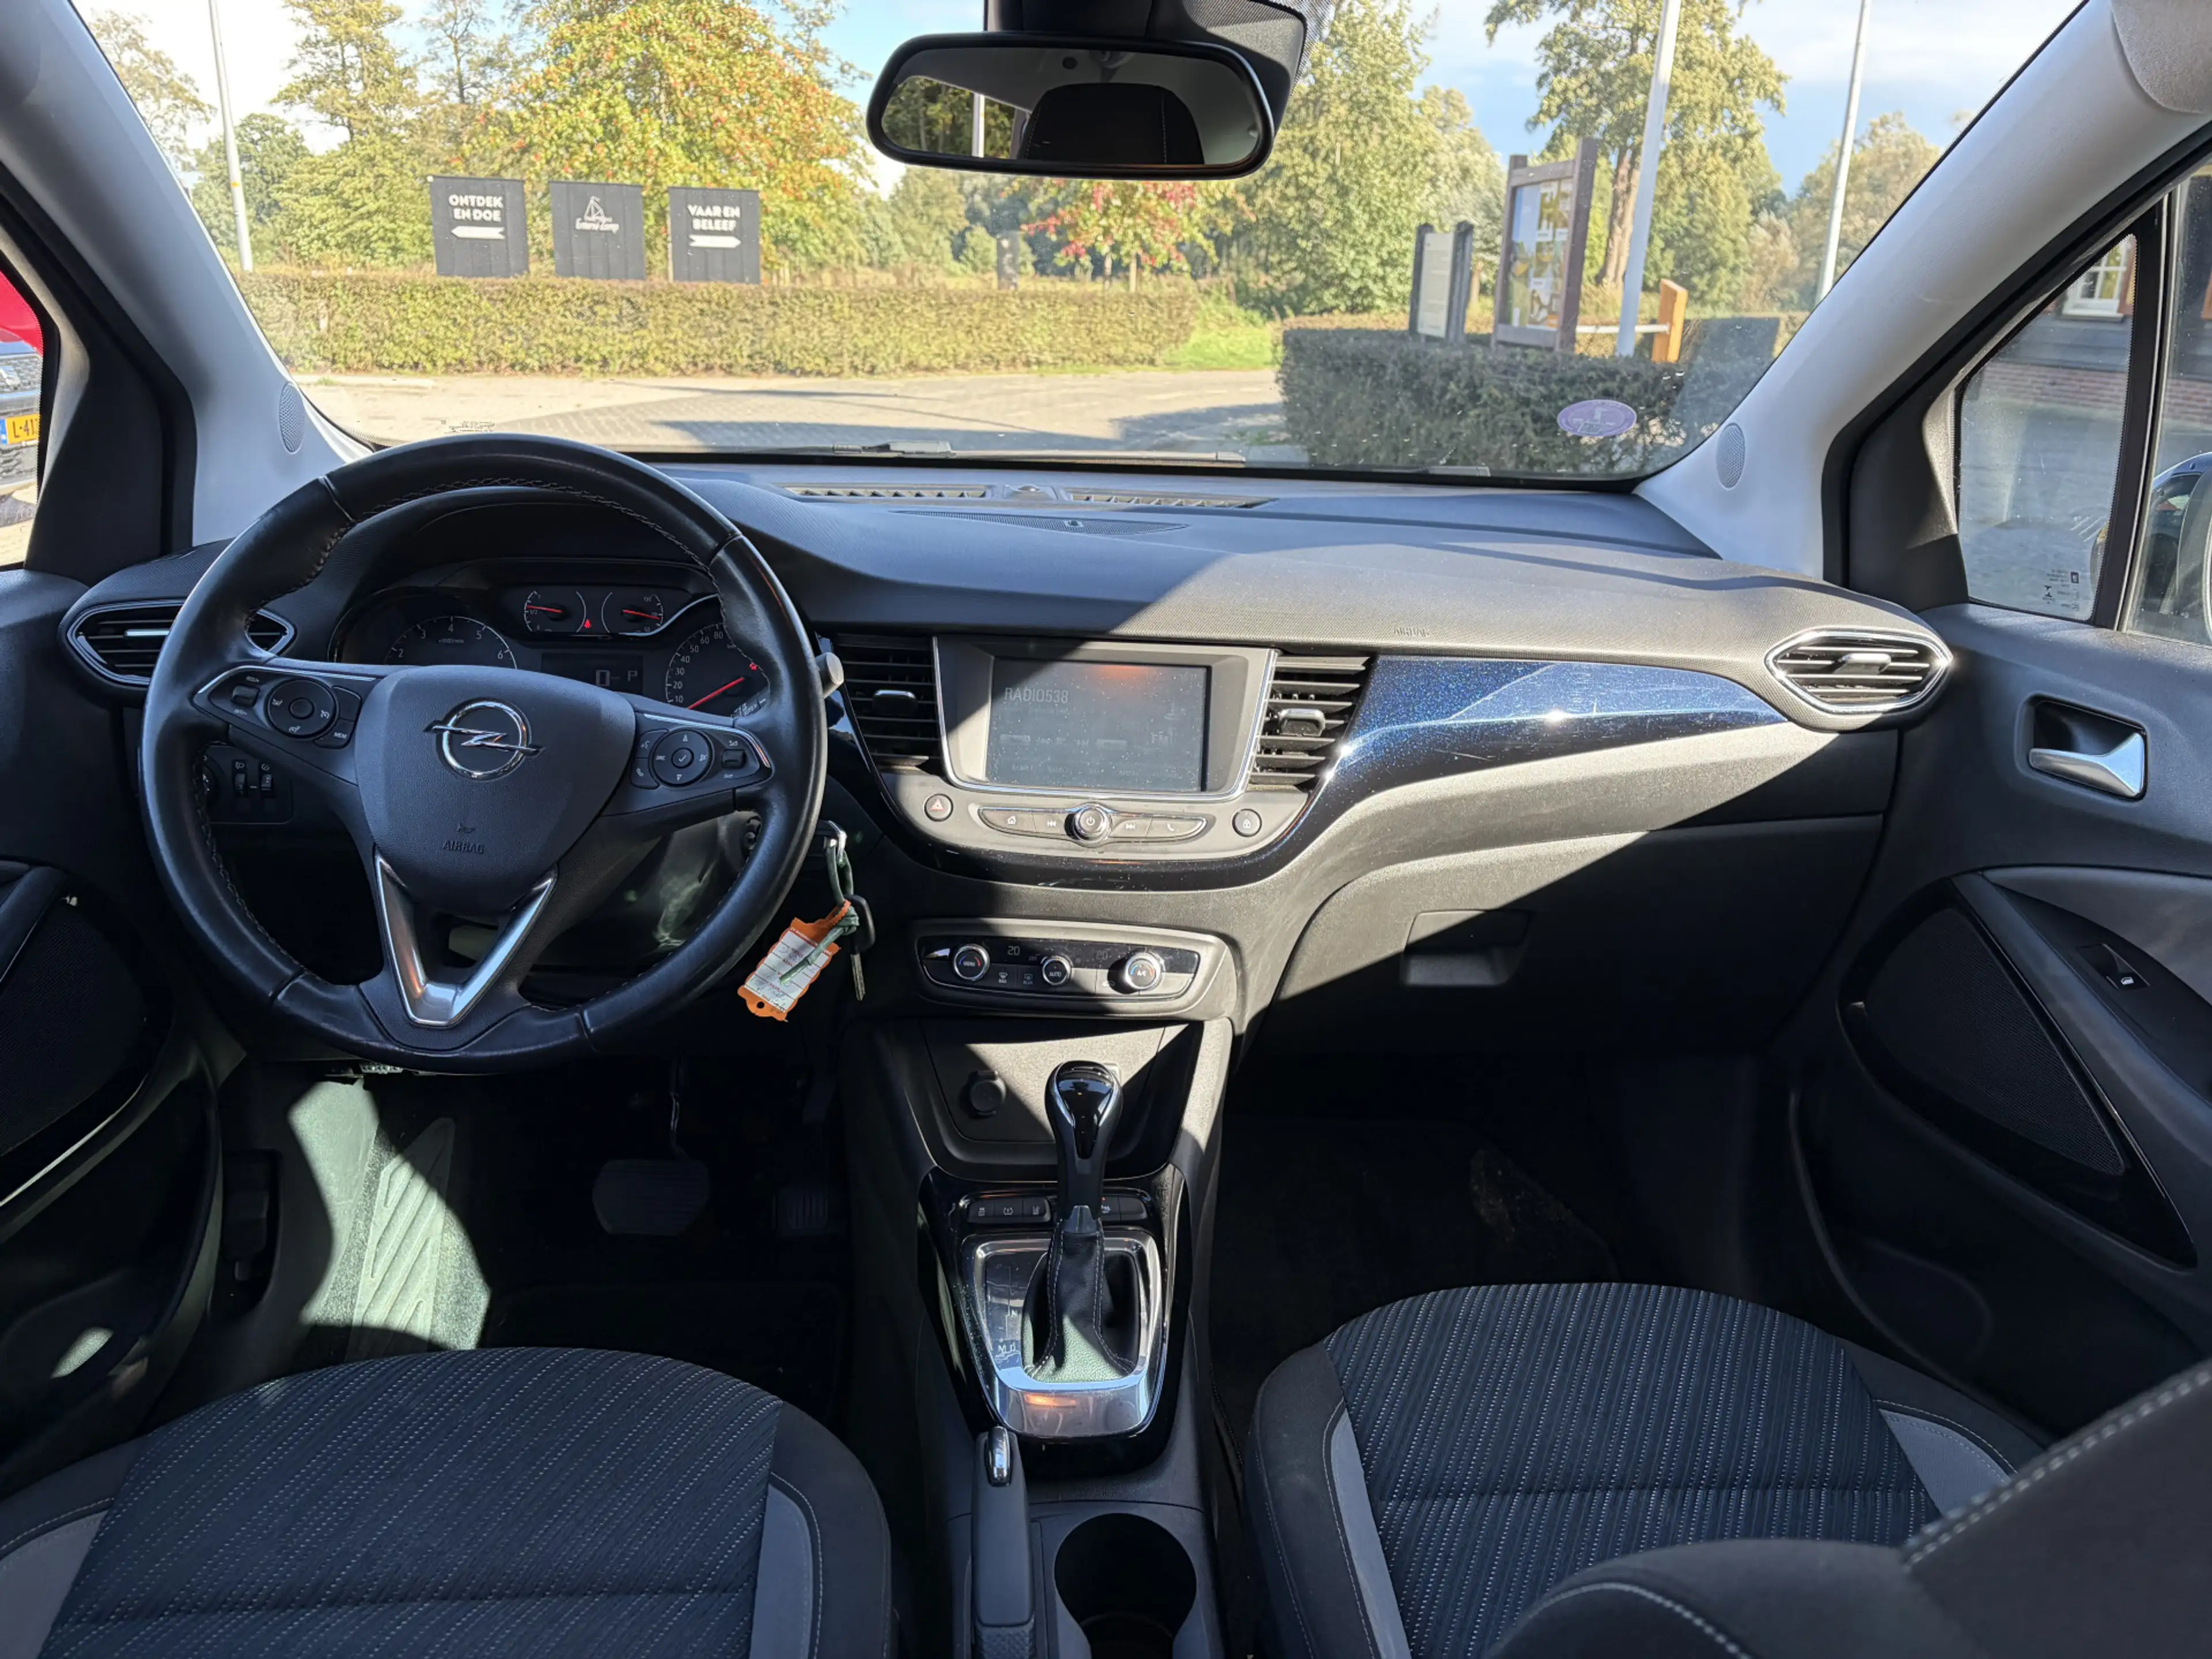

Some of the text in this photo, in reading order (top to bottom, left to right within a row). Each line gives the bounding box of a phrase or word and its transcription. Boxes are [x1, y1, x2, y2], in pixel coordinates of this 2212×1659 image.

[449, 195, 503, 208] ONTDEK
[453, 208, 501, 222] EN DOE
[687, 204, 722, 217] VAAR
[692, 218, 737, 231] BELEEF
[13, 418, 38, 438] L-41
[448, 623, 453, 632] 4
[421, 630, 426, 639] 3
[476, 630, 482, 639] 5
[714, 631, 723, 639] 80
[700, 636, 710, 644] 60
[398, 649, 403, 657] 2
[497, 650, 503, 659] 6
[627, 670, 638, 681] P
[673, 681, 683, 689] 20
[1004, 687, 1070, 704] RADIO538
[334, 731, 347, 740] MEM
[442, 840, 484, 855] AIRBAG
[1007, 946, 1020, 956] 20
